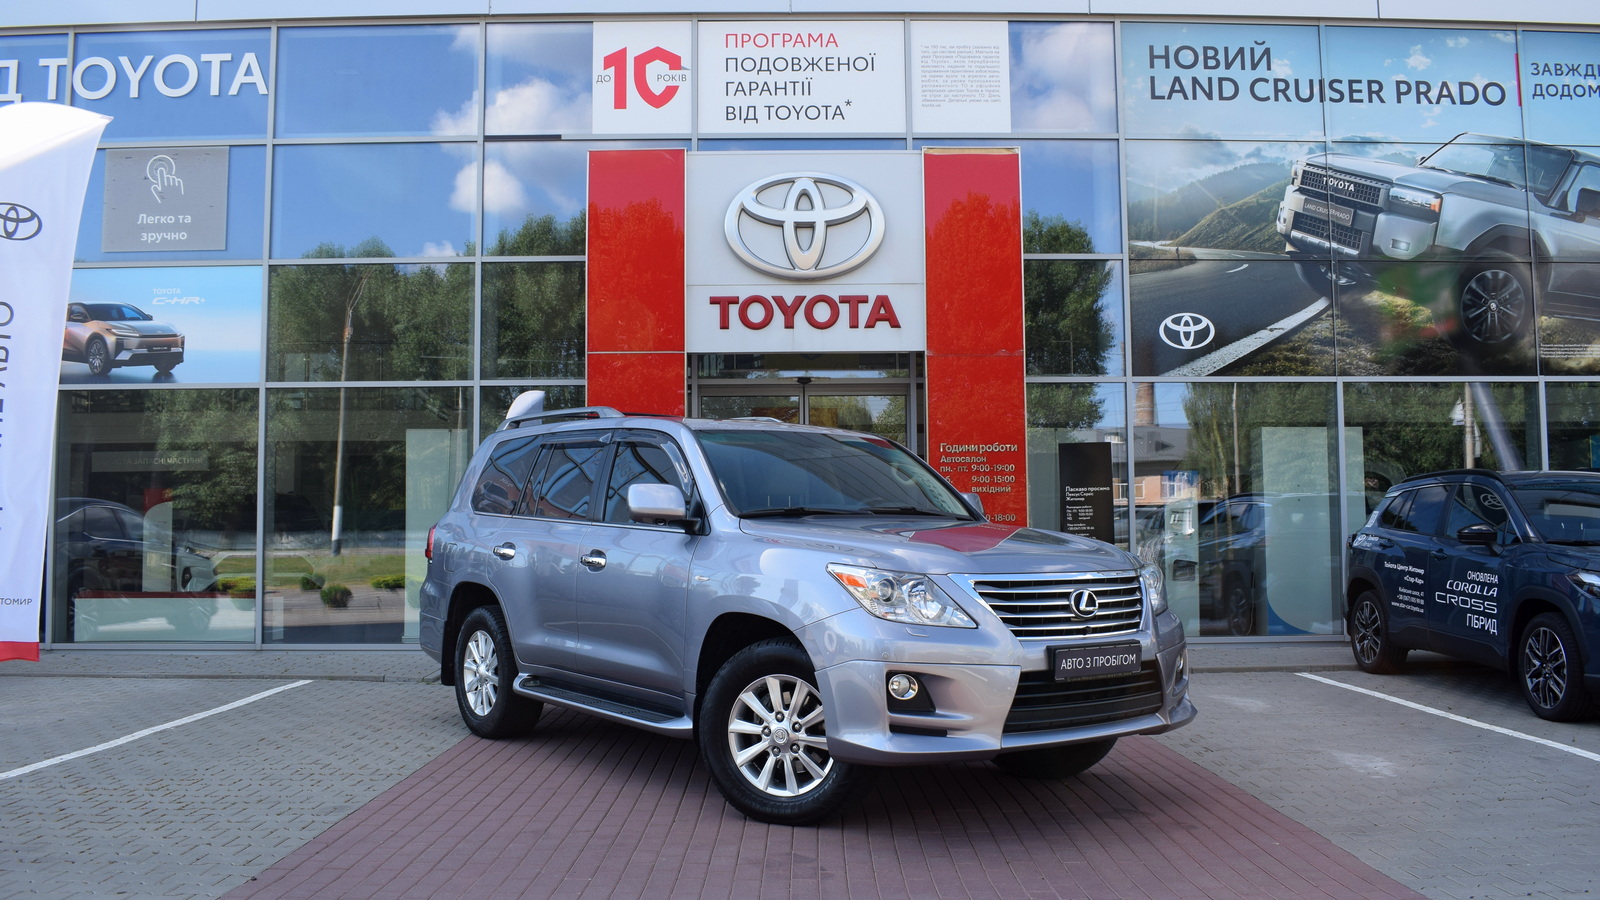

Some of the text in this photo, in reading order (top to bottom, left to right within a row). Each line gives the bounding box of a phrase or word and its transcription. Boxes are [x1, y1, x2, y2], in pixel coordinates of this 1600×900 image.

[725, 33, 839, 49] ПРОГРАМА
[725, 53, 877, 75] ПОДОВЖЕНОЇ
[1148, 40, 1272, 71] НОВИЙ
[38, 52, 269, 100] TOYOTA
[596, 74, 612, 84] ДО
[656, 73, 688, 83] РОКІВ
[1530, 62, 1600, 80] ЗАВЖД
[725, 77, 812, 97] ГАРАНТІЇ
[1149, 75, 1507, 107] LAND CRUISER PRADO
[1532, 83, 1600, 101] ДОДОМ
[725, 105, 759, 124] ВІД
[1323, 177, 1355, 191] TOYOTA
[1304, 203, 1316, 211] LAND
[137, 213, 192, 225] Легко та
[140, 231, 188, 243] зручно
[709, 294, 902, 330] TOYOTA
[940, 442, 1018, 454] Години роботи
[940, 455, 987, 463] Автосалон
[971, 485, 1011, 493] вихідний
[1467, 570, 1499, 584] ОНОВЛЕНА
[1446, 579, 1498, 598] COROLLA
[1435, 591, 1498, 614] CROSS
[1466, 613, 1498, 635] ГІБРИД
[1060, 653, 1137, 670] АВТО З ПРОБІГОМ
